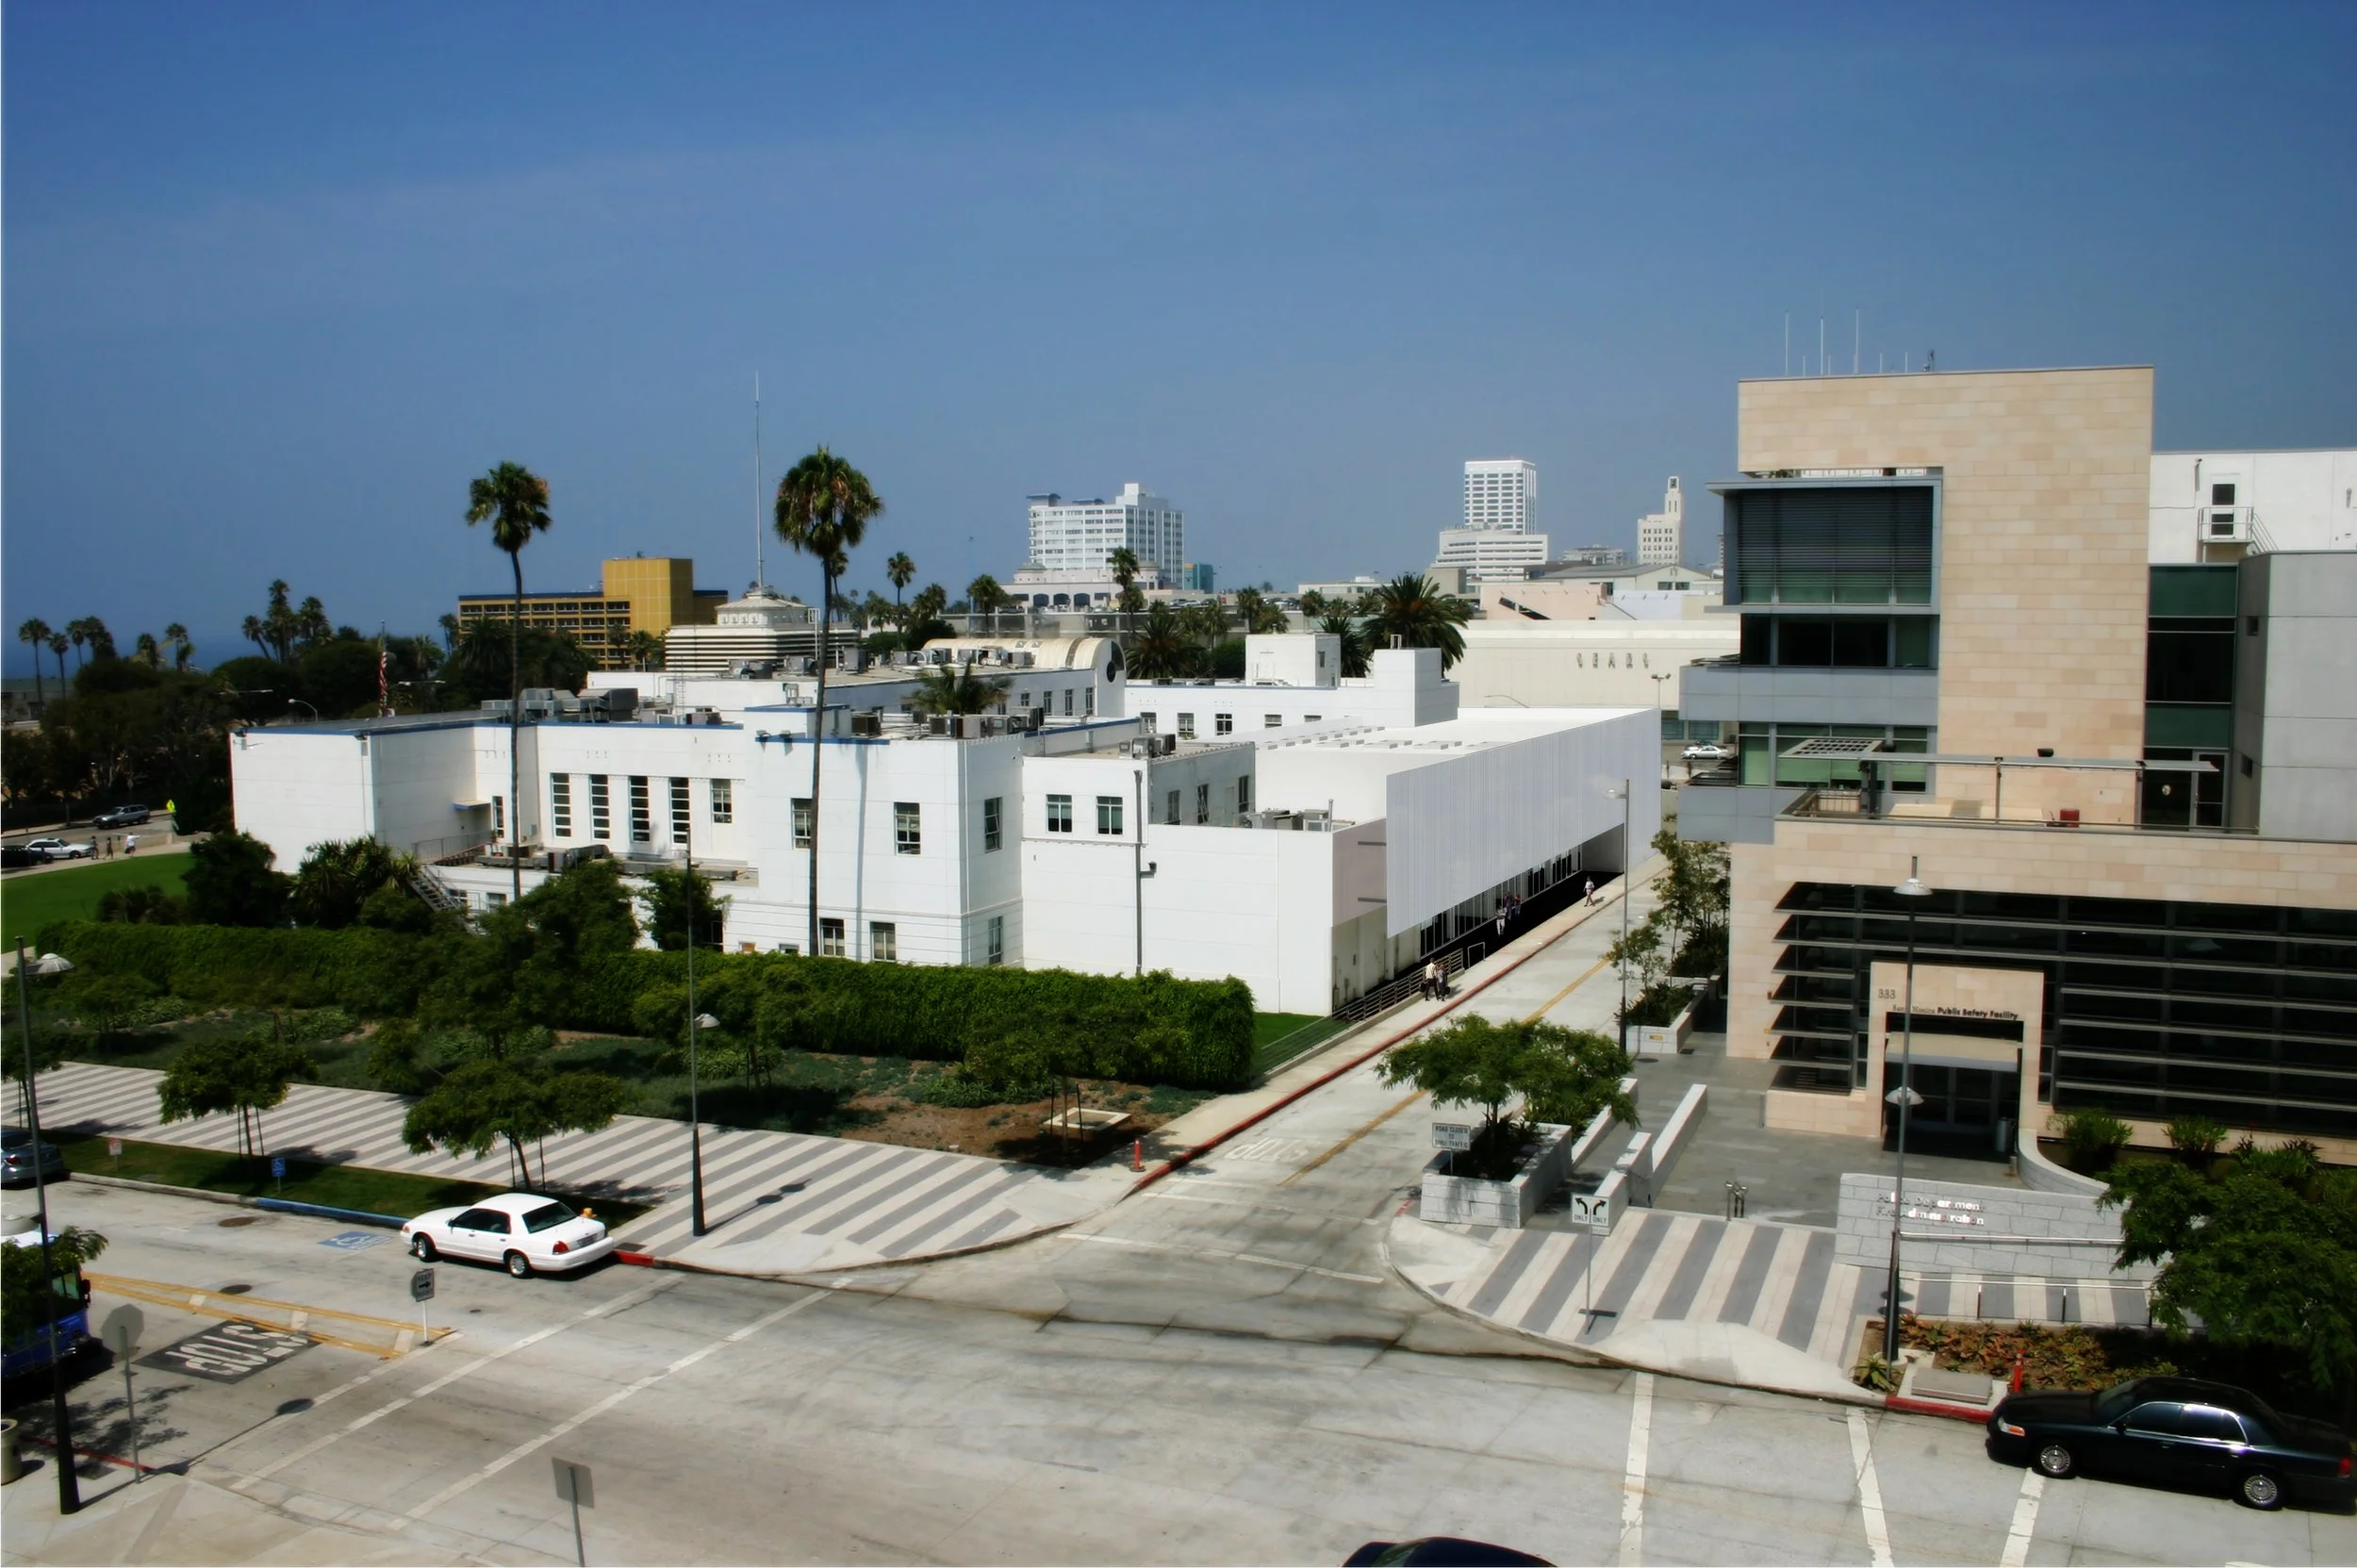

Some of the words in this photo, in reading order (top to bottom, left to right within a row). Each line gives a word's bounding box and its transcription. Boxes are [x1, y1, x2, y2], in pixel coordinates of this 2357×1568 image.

[1576, 652, 1649, 668] SEARS
[1878, 988, 1896, 999] 333
[1937, 1006, 1960, 1015] Public
[1962, 1008, 1988, 1018] Safety
[1989, 1010, 2019, 1021] Facility
[1449, 1126, 1468, 1134] CLOSED
[1574, 1214, 1588, 1223] ONLY
[1592, 1215, 1607, 1224] ONLY
[164, 1324, 309, 1377] STOP
